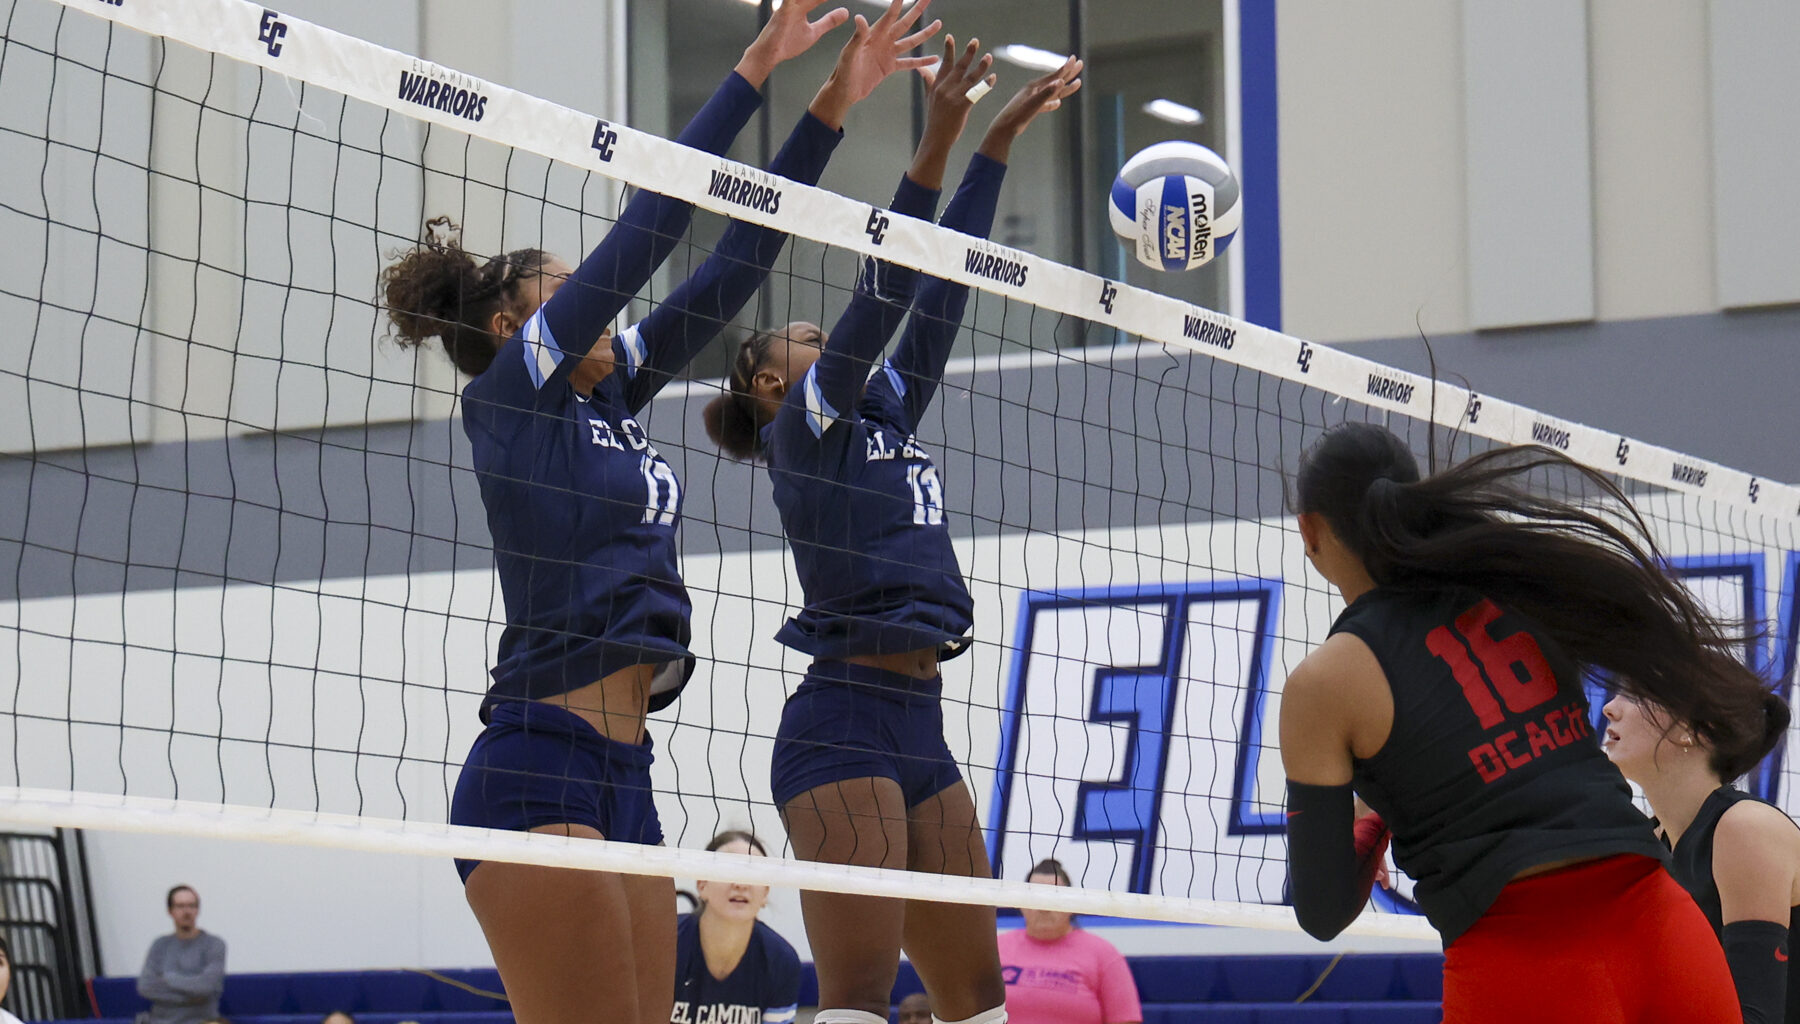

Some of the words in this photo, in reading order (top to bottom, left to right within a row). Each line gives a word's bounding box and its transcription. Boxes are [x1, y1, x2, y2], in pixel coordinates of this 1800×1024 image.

[258, 9, 287, 57] EC
[398, 70, 488, 122] WARRIORS
[591, 119, 617, 162] EC
[708, 169, 782, 215] WARRIORS
[865, 206, 889, 246] EC
[1163, 204, 1186, 260] NCAA
[1191, 193, 1211, 260] molten
[965, 248, 1028, 287] WARRIORS
[1098, 279, 1117, 315] EC
[1183, 314, 1236, 350] WARRIORS
[1297, 341, 1313, 373] EC
[1366, 373, 1414, 404] WARRIORS
[588, 418, 625, 452] EL
[906, 464, 943, 525] 13
[1425, 598, 1558, 730] 16
[670, 1001, 692, 1024] EL
[696, 1003, 761, 1024] CAMINO
